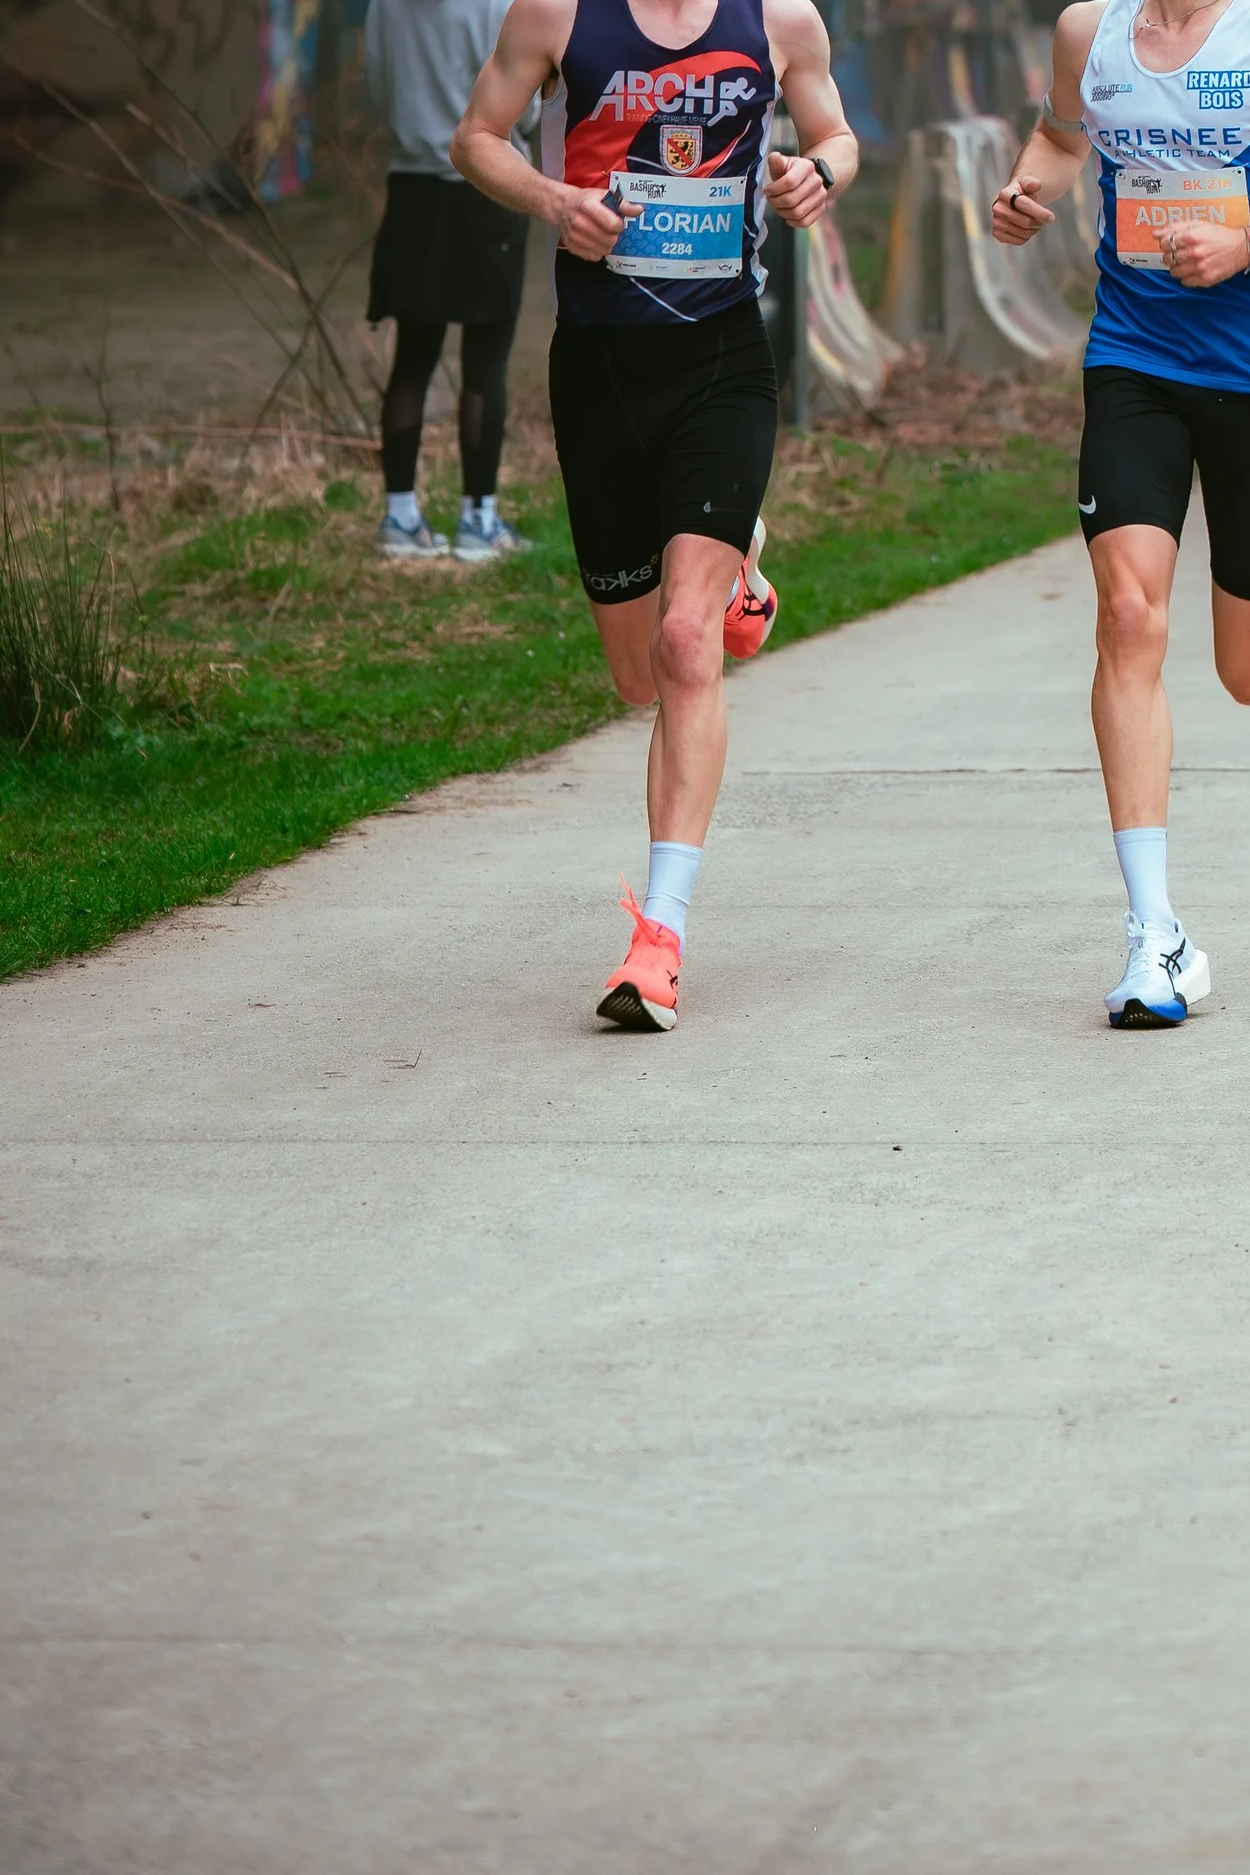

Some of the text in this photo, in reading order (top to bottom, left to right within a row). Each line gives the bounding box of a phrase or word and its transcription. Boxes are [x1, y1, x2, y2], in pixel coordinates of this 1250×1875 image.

[589, 70, 714, 121] ARCH
[1200, 91, 1243, 108] BOIS
[1098, 127, 1243, 147] CRISNEE
[1187, 149, 1230, 158] TEAM
[1183, 180, 1201, 191] BK
[1207, 177, 1233, 190] 21K
[708, 186, 732, 198] 21K
[1135, 205, 1226, 227] ADRIEN
[661, 242, 693, 255] 2284
